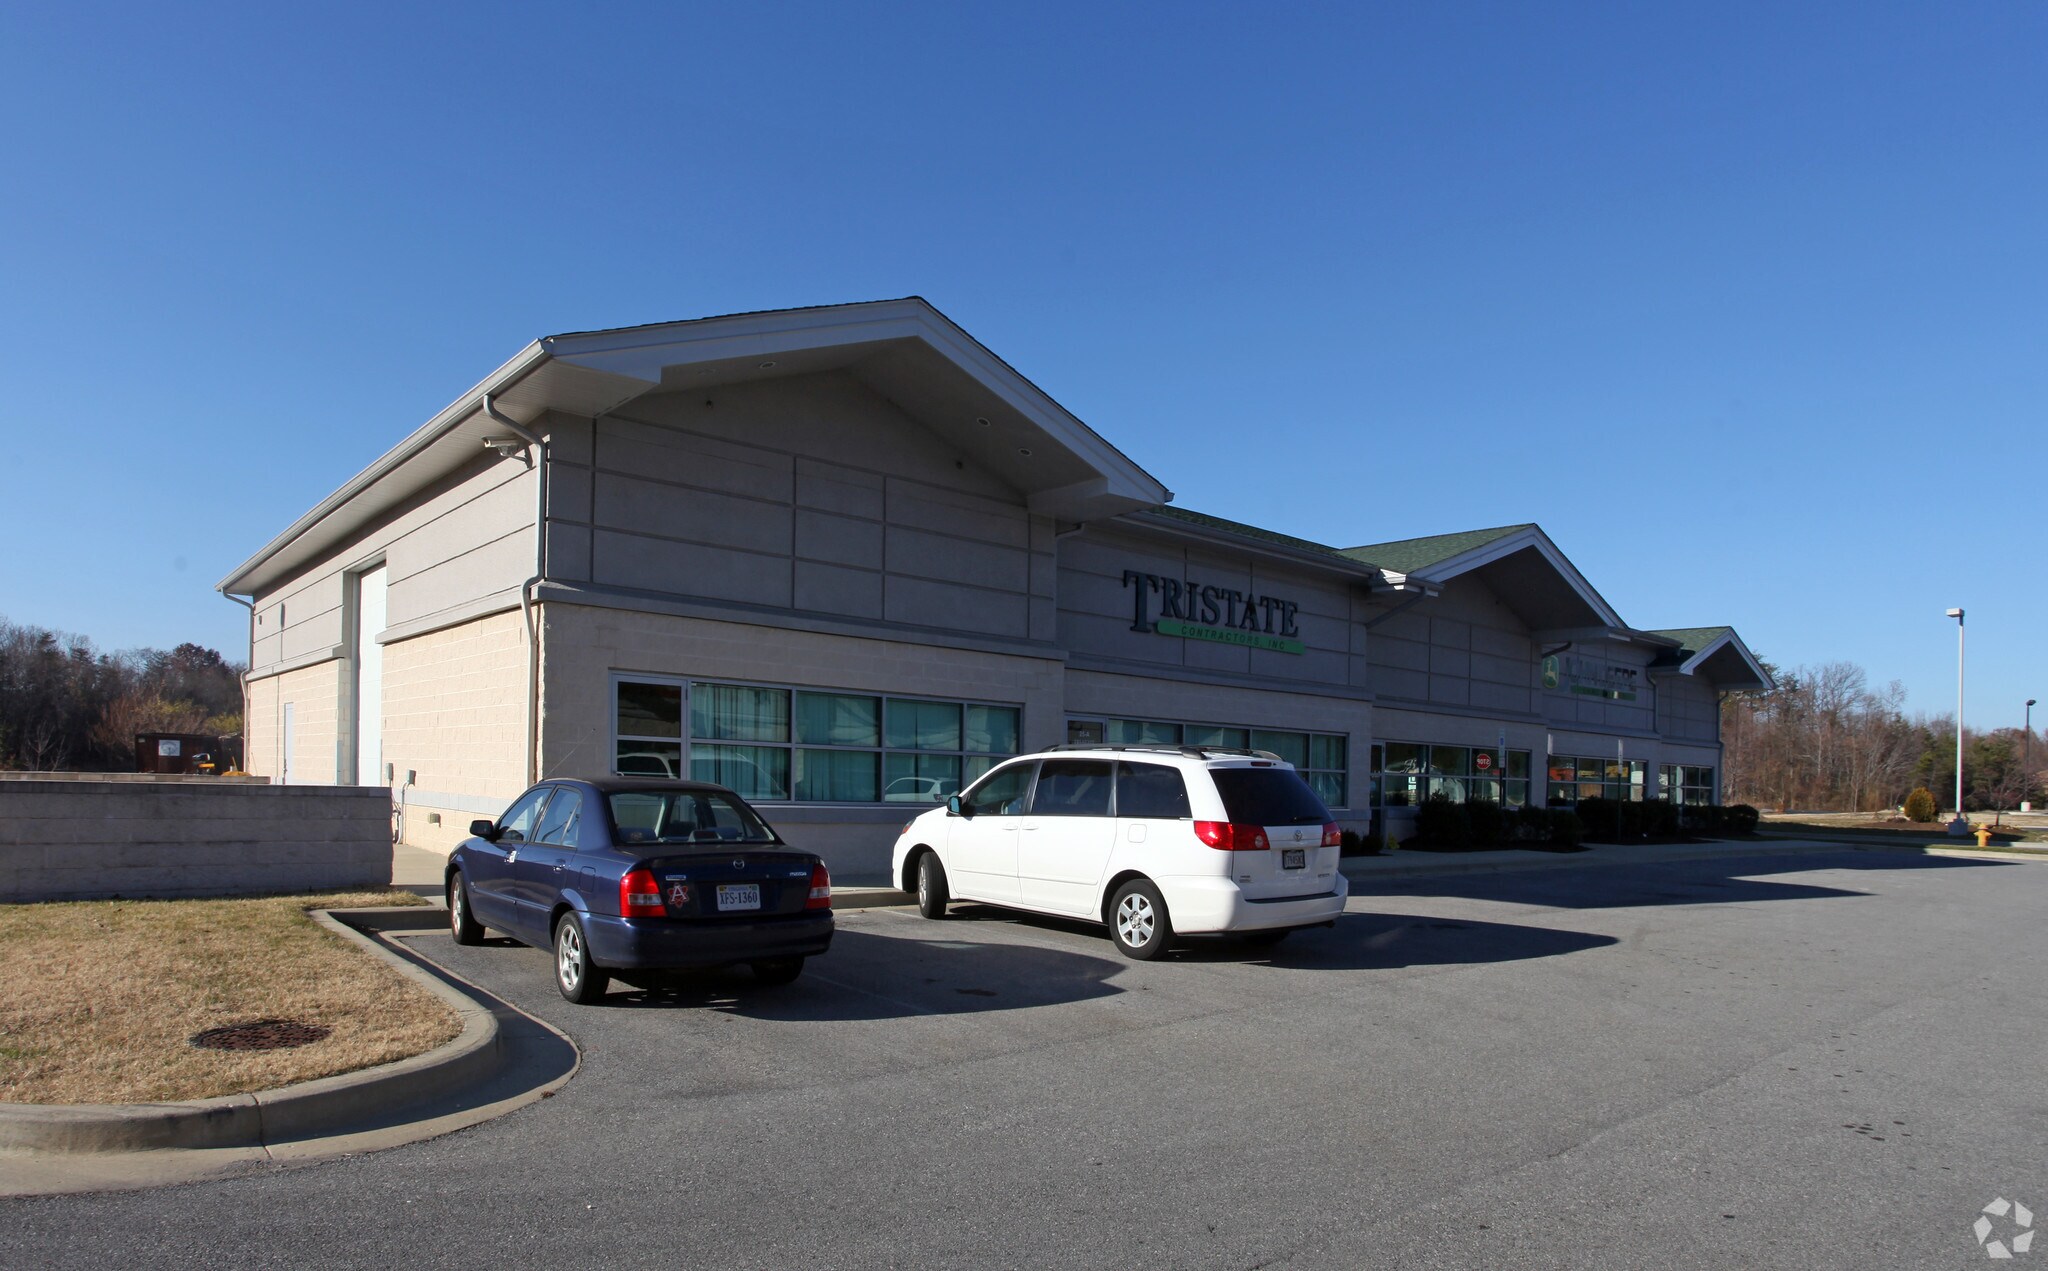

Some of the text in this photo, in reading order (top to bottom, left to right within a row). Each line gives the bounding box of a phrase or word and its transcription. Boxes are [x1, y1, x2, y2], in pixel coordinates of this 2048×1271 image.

[1123, 570, 1299, 637] TRISTATE
[1267, 638, 1286, 650] INC
[671, 886, 687, 901] A
[720, 891, 758, 905] XFS-1360
